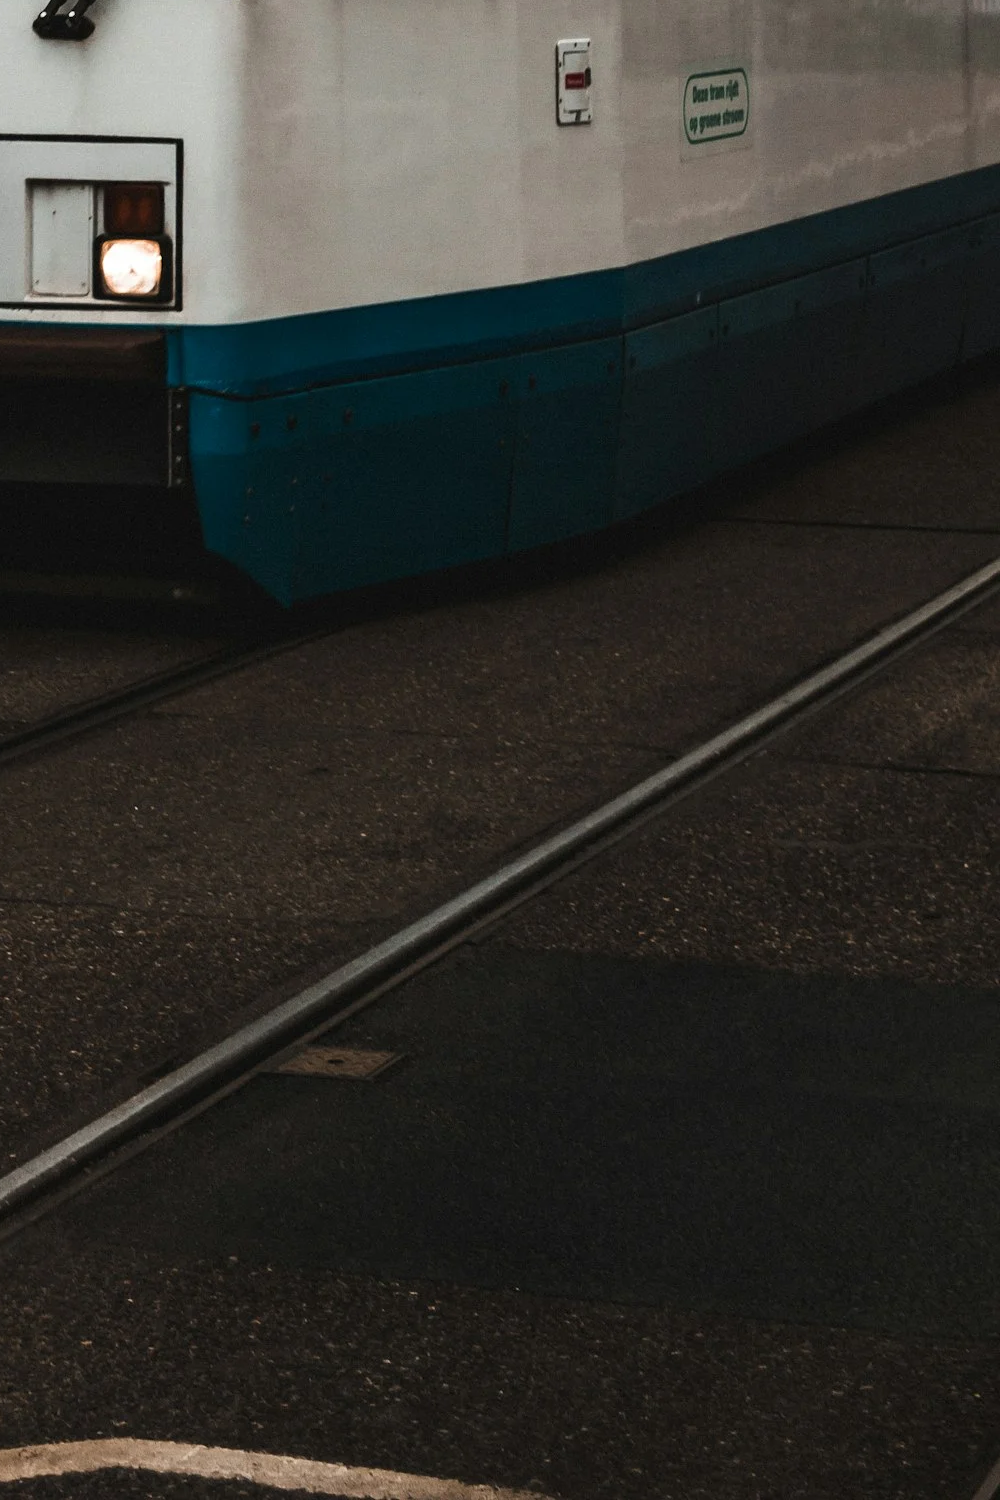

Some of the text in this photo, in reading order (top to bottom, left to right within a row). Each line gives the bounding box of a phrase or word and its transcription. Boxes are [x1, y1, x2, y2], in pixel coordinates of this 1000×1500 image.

[709, 83, 725, 101] tram
[689, 108, 744, 135] op groene stroom
